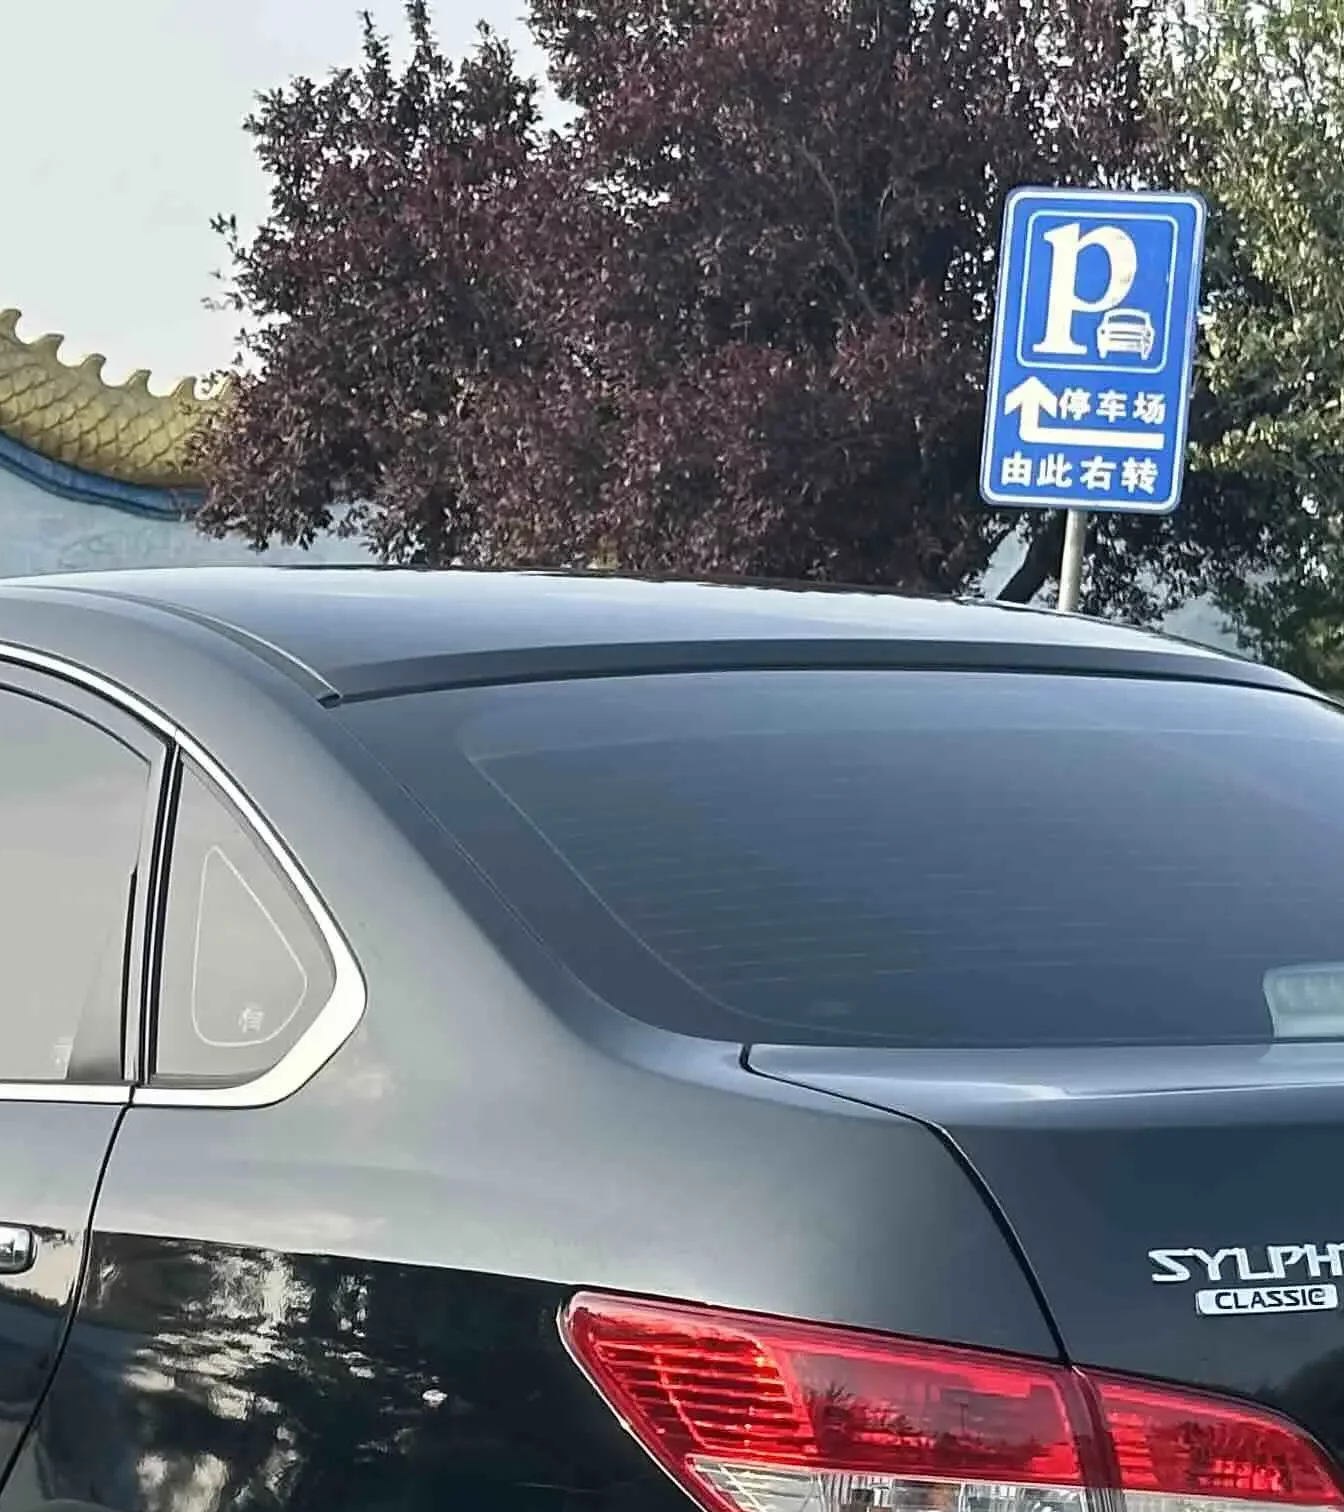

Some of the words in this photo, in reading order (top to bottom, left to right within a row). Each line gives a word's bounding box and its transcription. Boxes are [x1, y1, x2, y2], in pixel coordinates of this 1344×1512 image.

[1059, 388, 1166, 425] 停车场
[1000, 451, 1160, 495] 由此右转
[1214, 1288, 1326, 1310] CLASSIC
